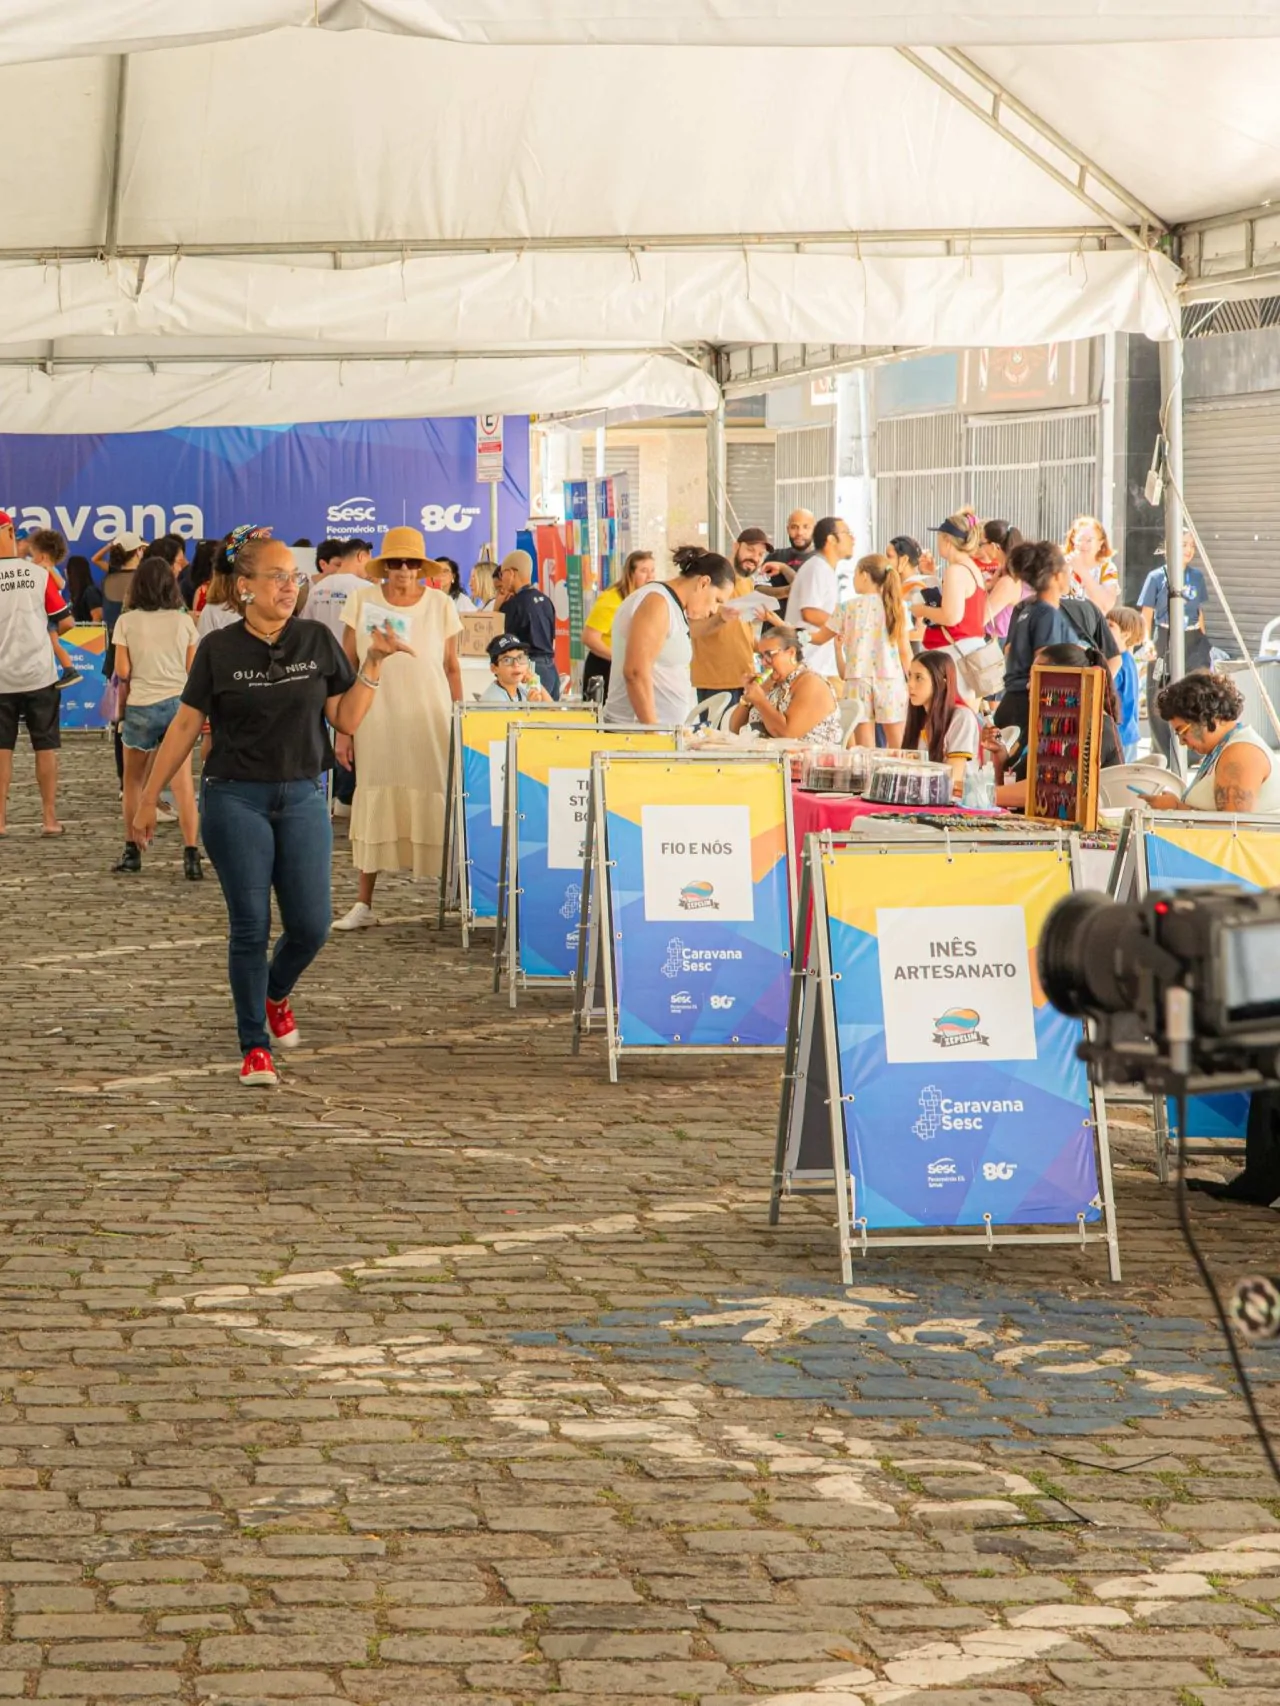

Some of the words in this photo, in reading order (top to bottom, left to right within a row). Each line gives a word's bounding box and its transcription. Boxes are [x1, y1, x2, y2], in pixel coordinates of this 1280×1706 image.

[326, 504, 376, 522] Sesc
[0, 582, 16, 592] COM
[16, 580, 35, 590] ARCO
[661, 842, 686, 855] FIO
[689, 842, 699, 855] E
[701, 839, 733, 855] NÓS
[681, 948, 743, 960] Caravana
[930, 936, 978, 958] INÊS
[682, 960, 713, 972] Sesc
[894, 963, 1017, 980] ARTESANATO
[940, 1099, 1024, 1114] Caravana
[941, 1115, 983, 1130] Sesc
[927, 1163, 957, 1174] Sesc
